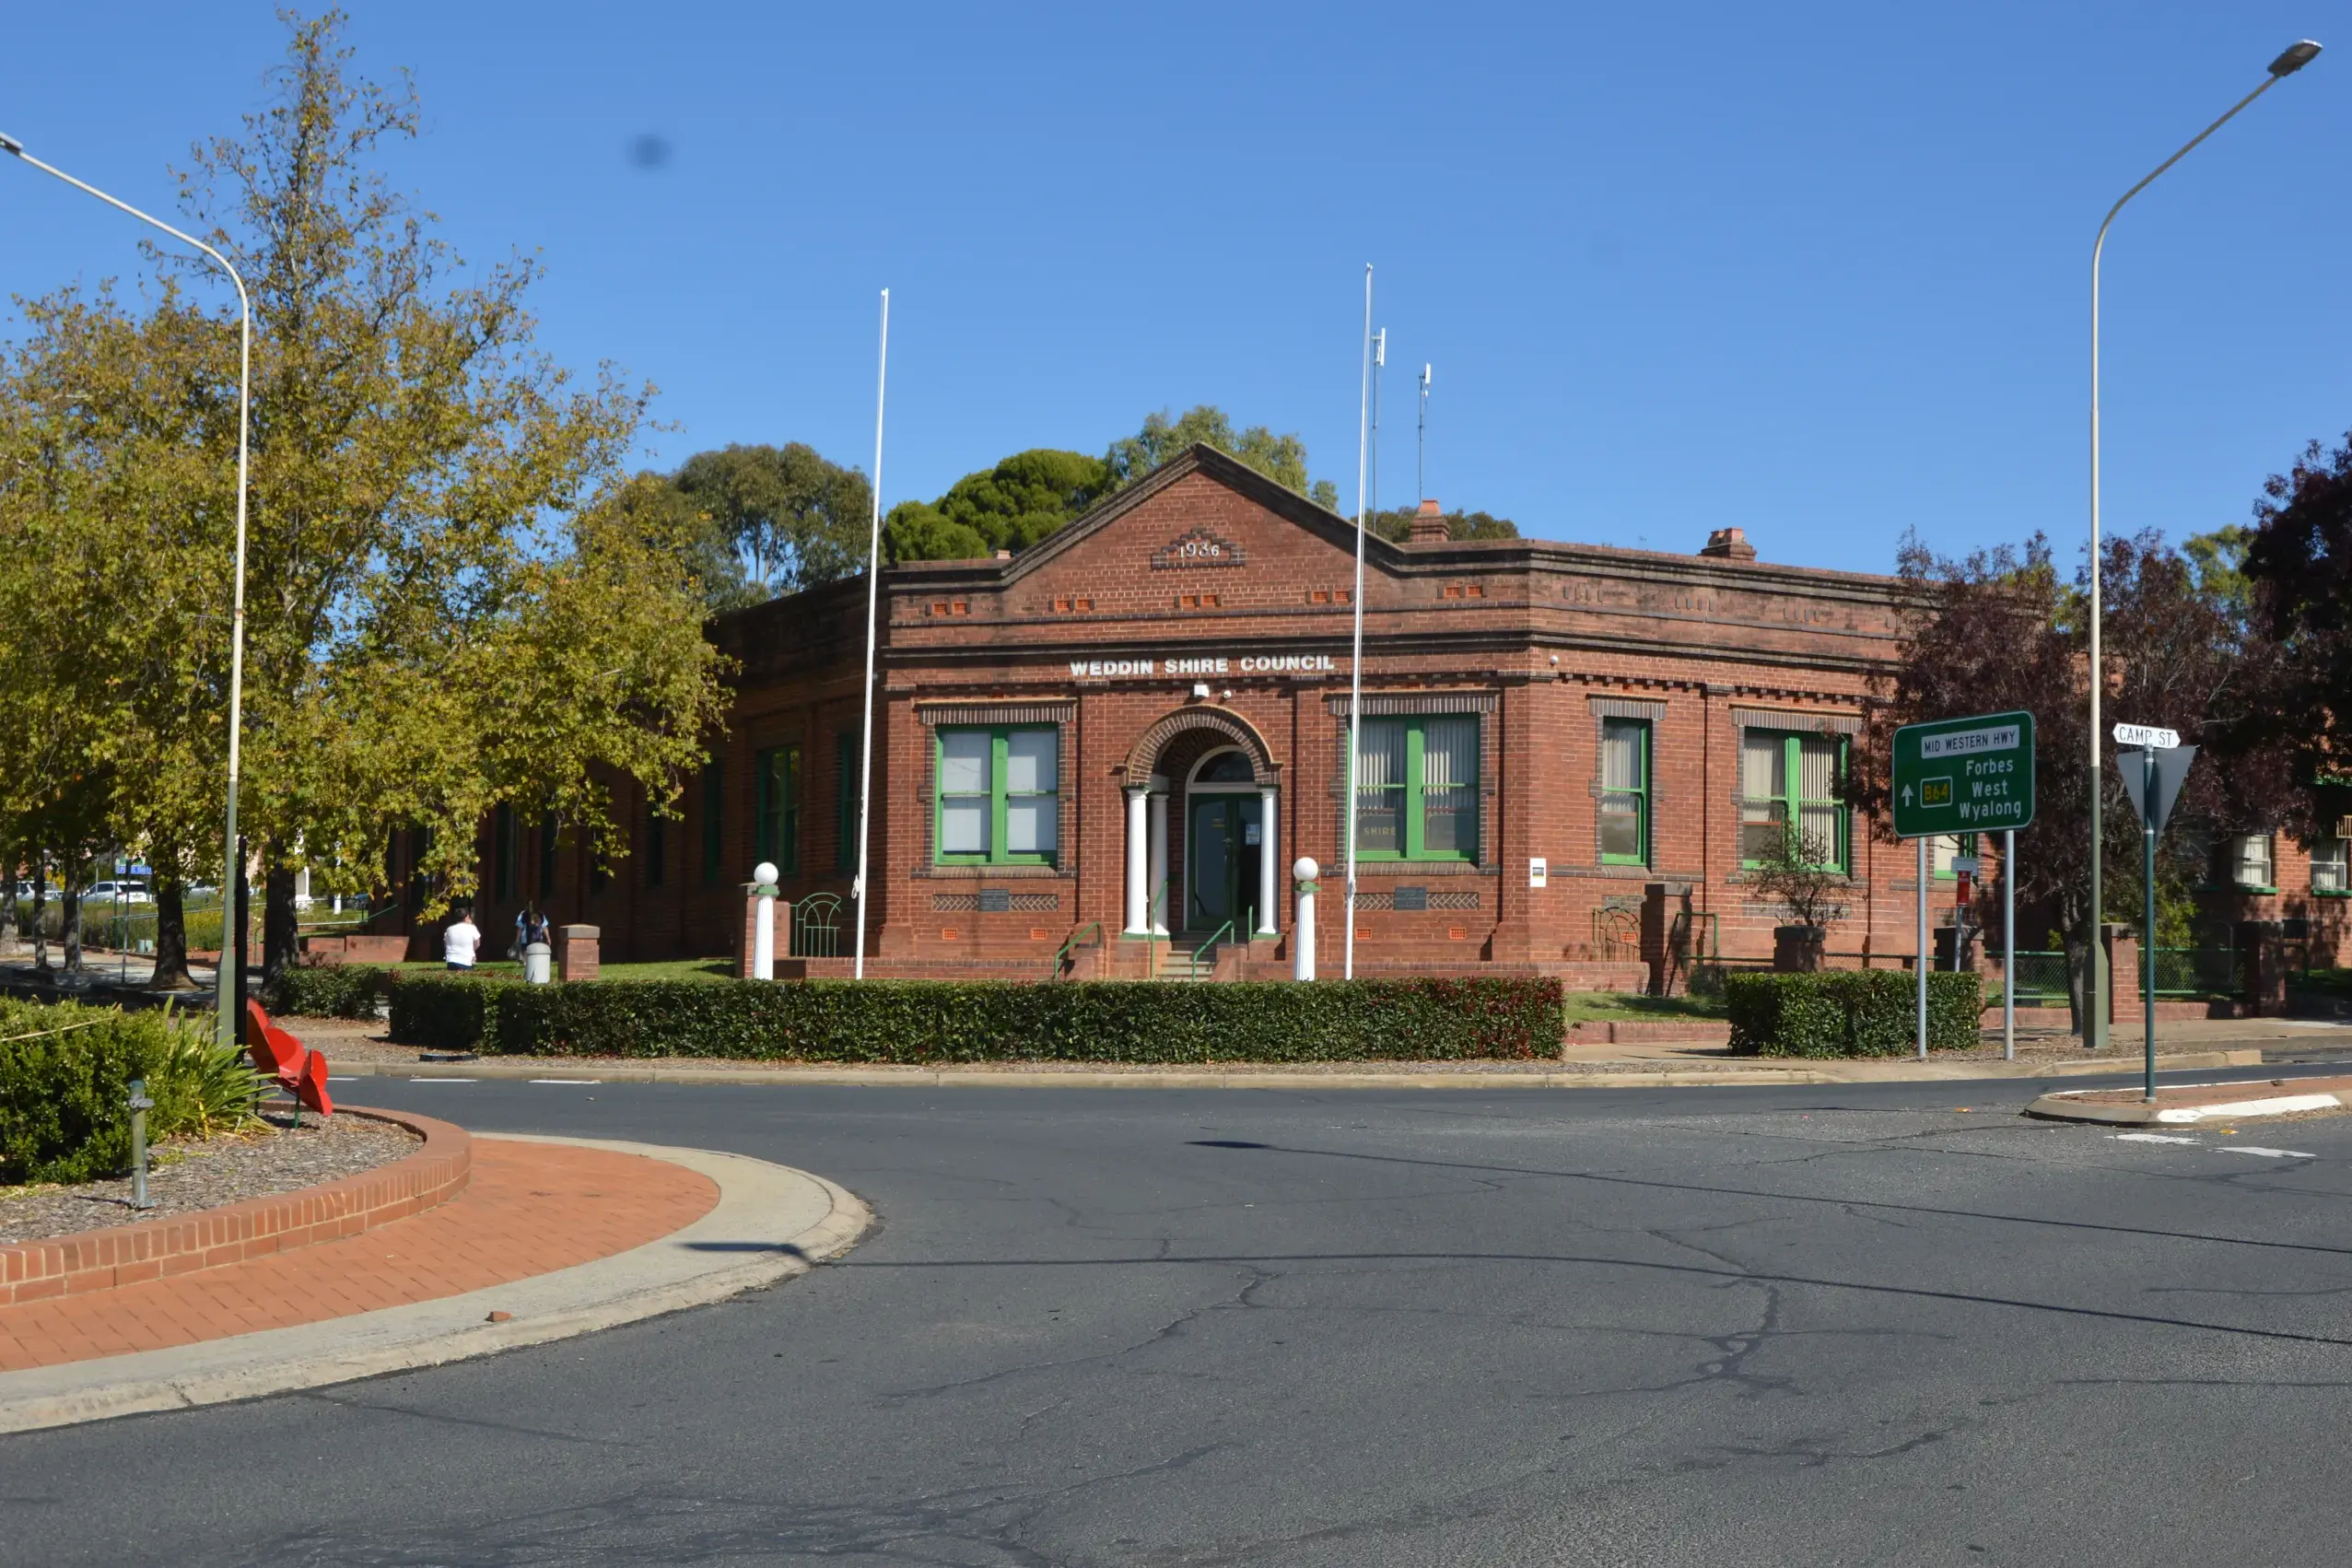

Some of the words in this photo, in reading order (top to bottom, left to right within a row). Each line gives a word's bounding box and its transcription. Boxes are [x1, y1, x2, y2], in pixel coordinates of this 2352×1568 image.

[1180, 543, 1220, 557] 1936
[1070, 660, 1153, 676] WEDDIN
[1164, 657, 1229, 673] SHIRE
[1240, 655, 1335, 671] COUNCIL
[1924, 740, 1940, 753] MID
[1945, 733, 1988, 751] WESTERN
[1993, 730, 2016, 744] HWY
[2119, 726, 2152, 743] CAMP
[2159, 731, 2172, 746] ST
[1966, 757, 2013, 776] Forbes
[1925, 783, 1948, 801] B64
[1972, 779, 2007, 798] West
[1959, 800, 2021, 822] Wyalong
[1363, 826, 1396, 837] SHIRE
